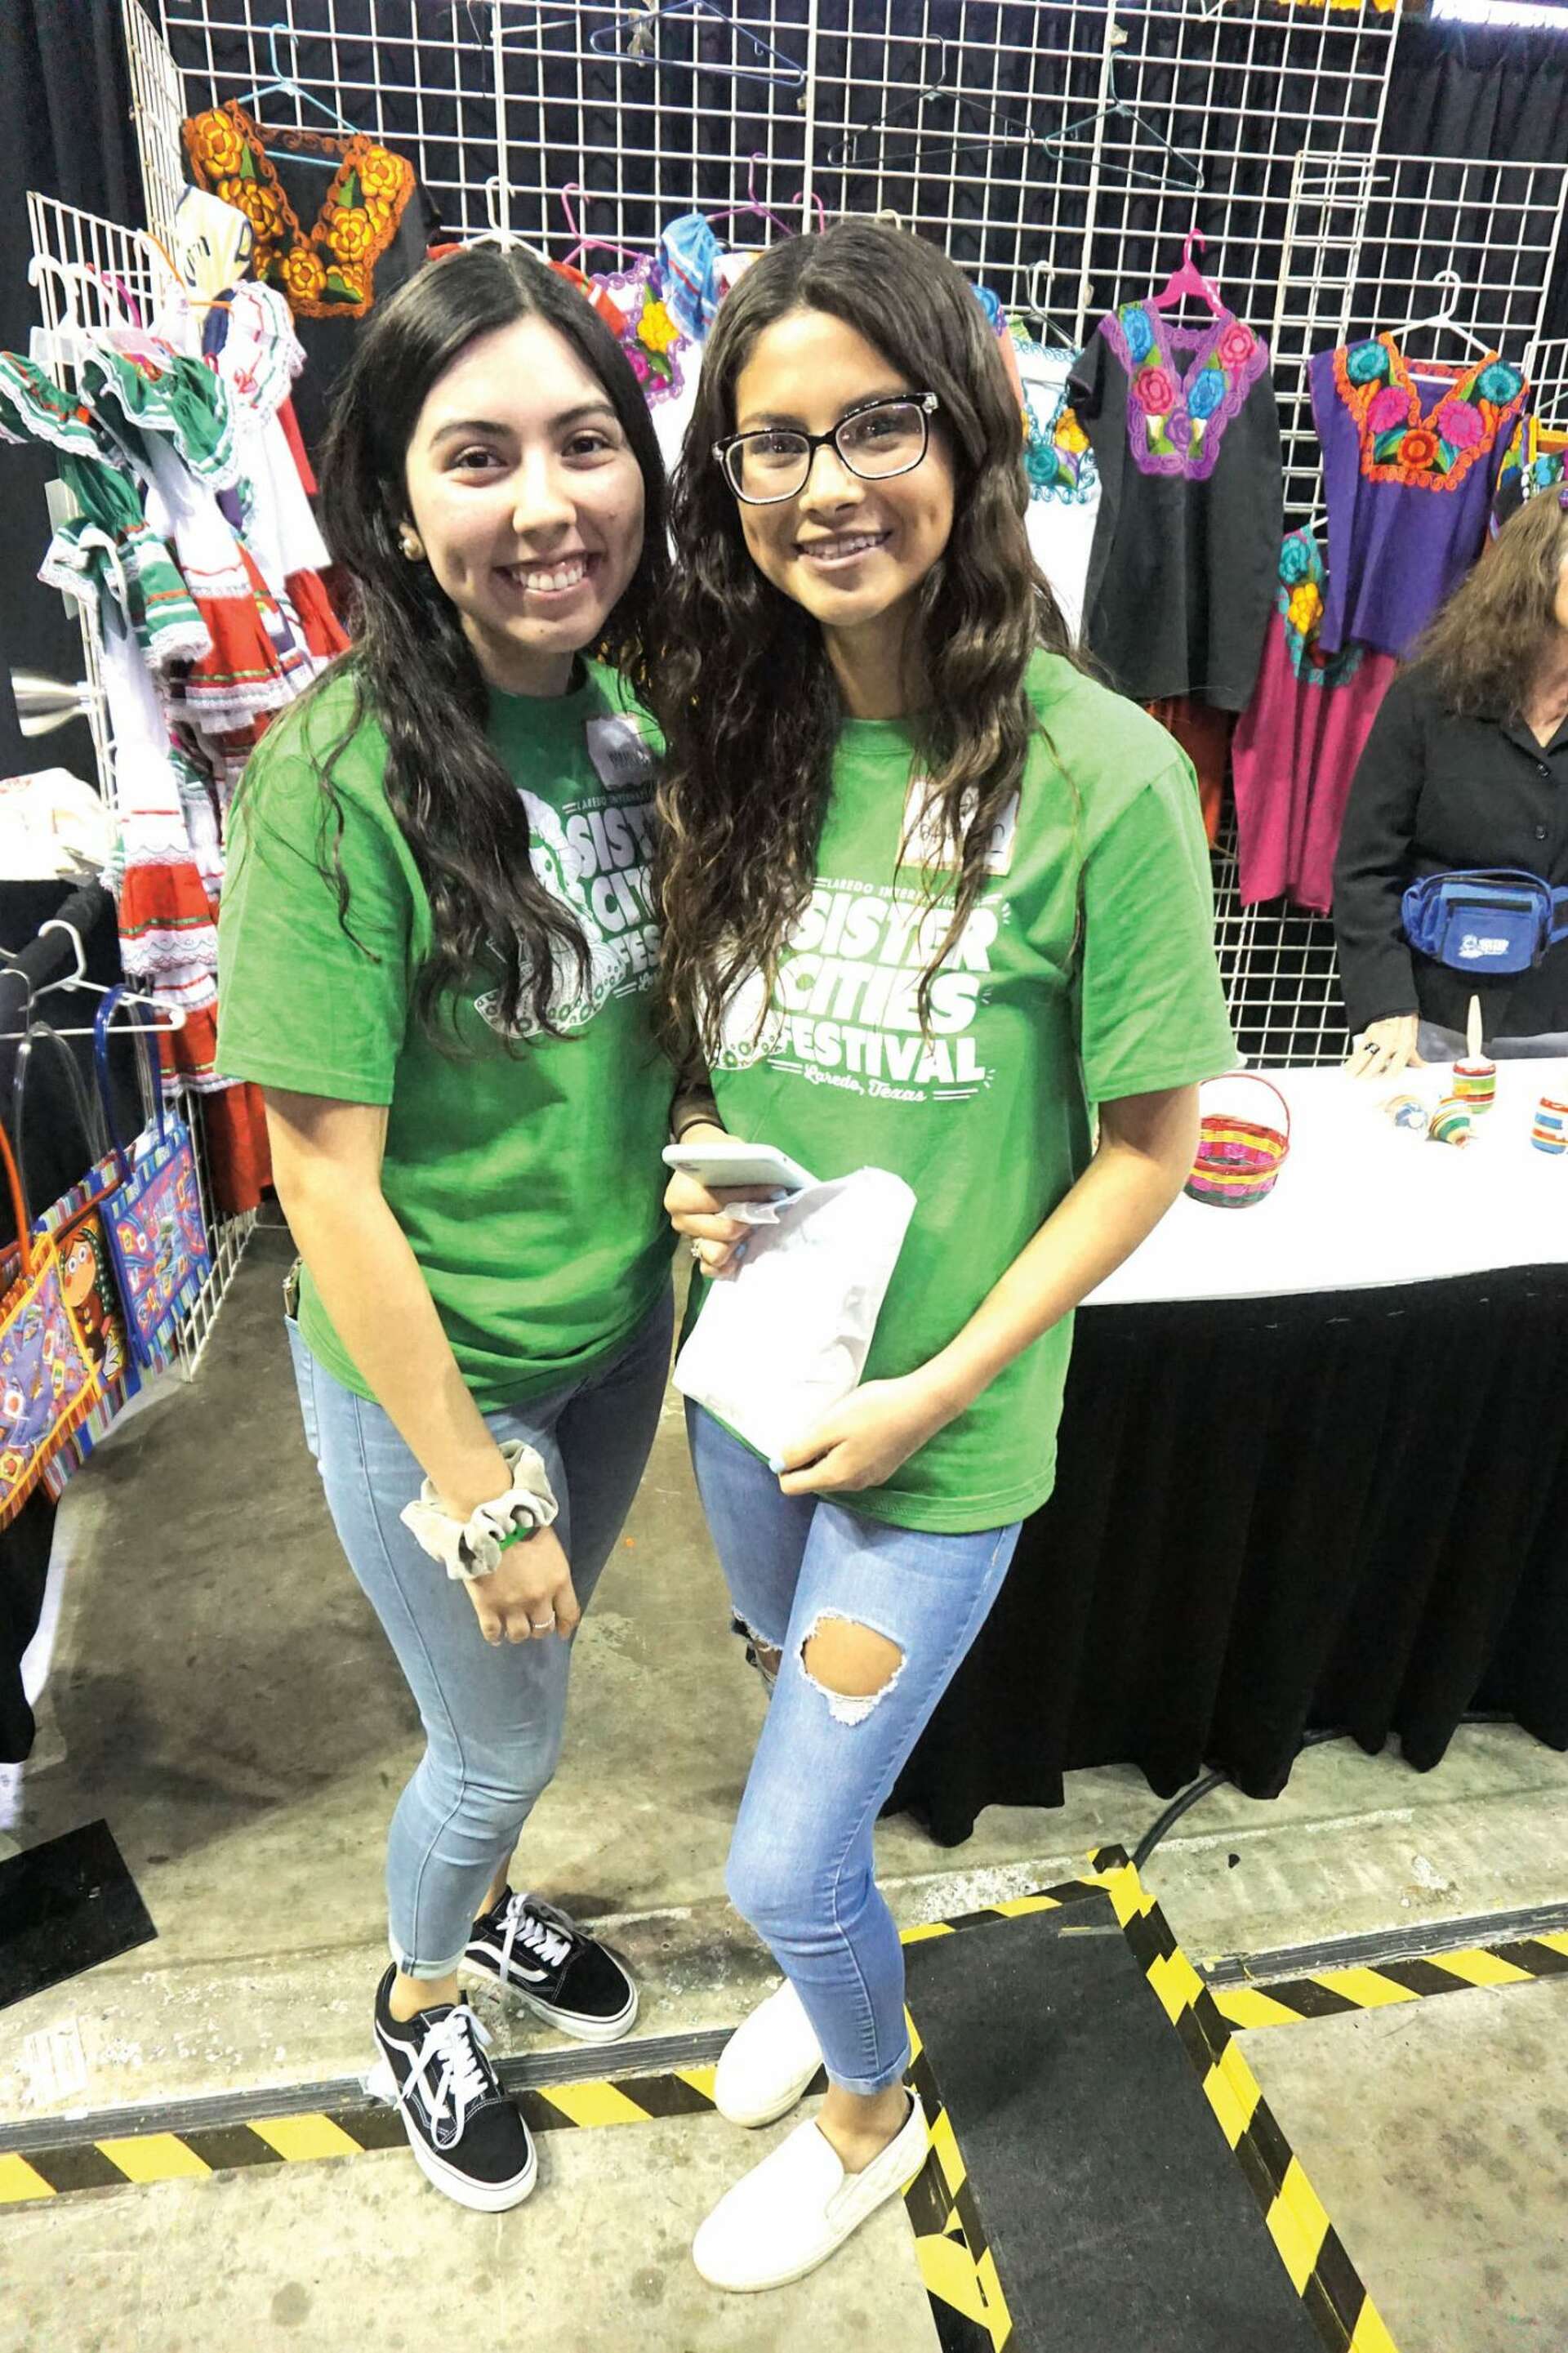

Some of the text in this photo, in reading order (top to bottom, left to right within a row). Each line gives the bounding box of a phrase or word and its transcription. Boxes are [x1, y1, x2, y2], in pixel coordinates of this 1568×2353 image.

[826, 878, 874, 894] LAREDO
[786, 890, 998, 972] SISTER
[774, 953, 980, 1034] CITIES
[782, 1013, 985, 1084] FESTIVAL
[804, 1063, 927, 1102] Laredo, Texas
